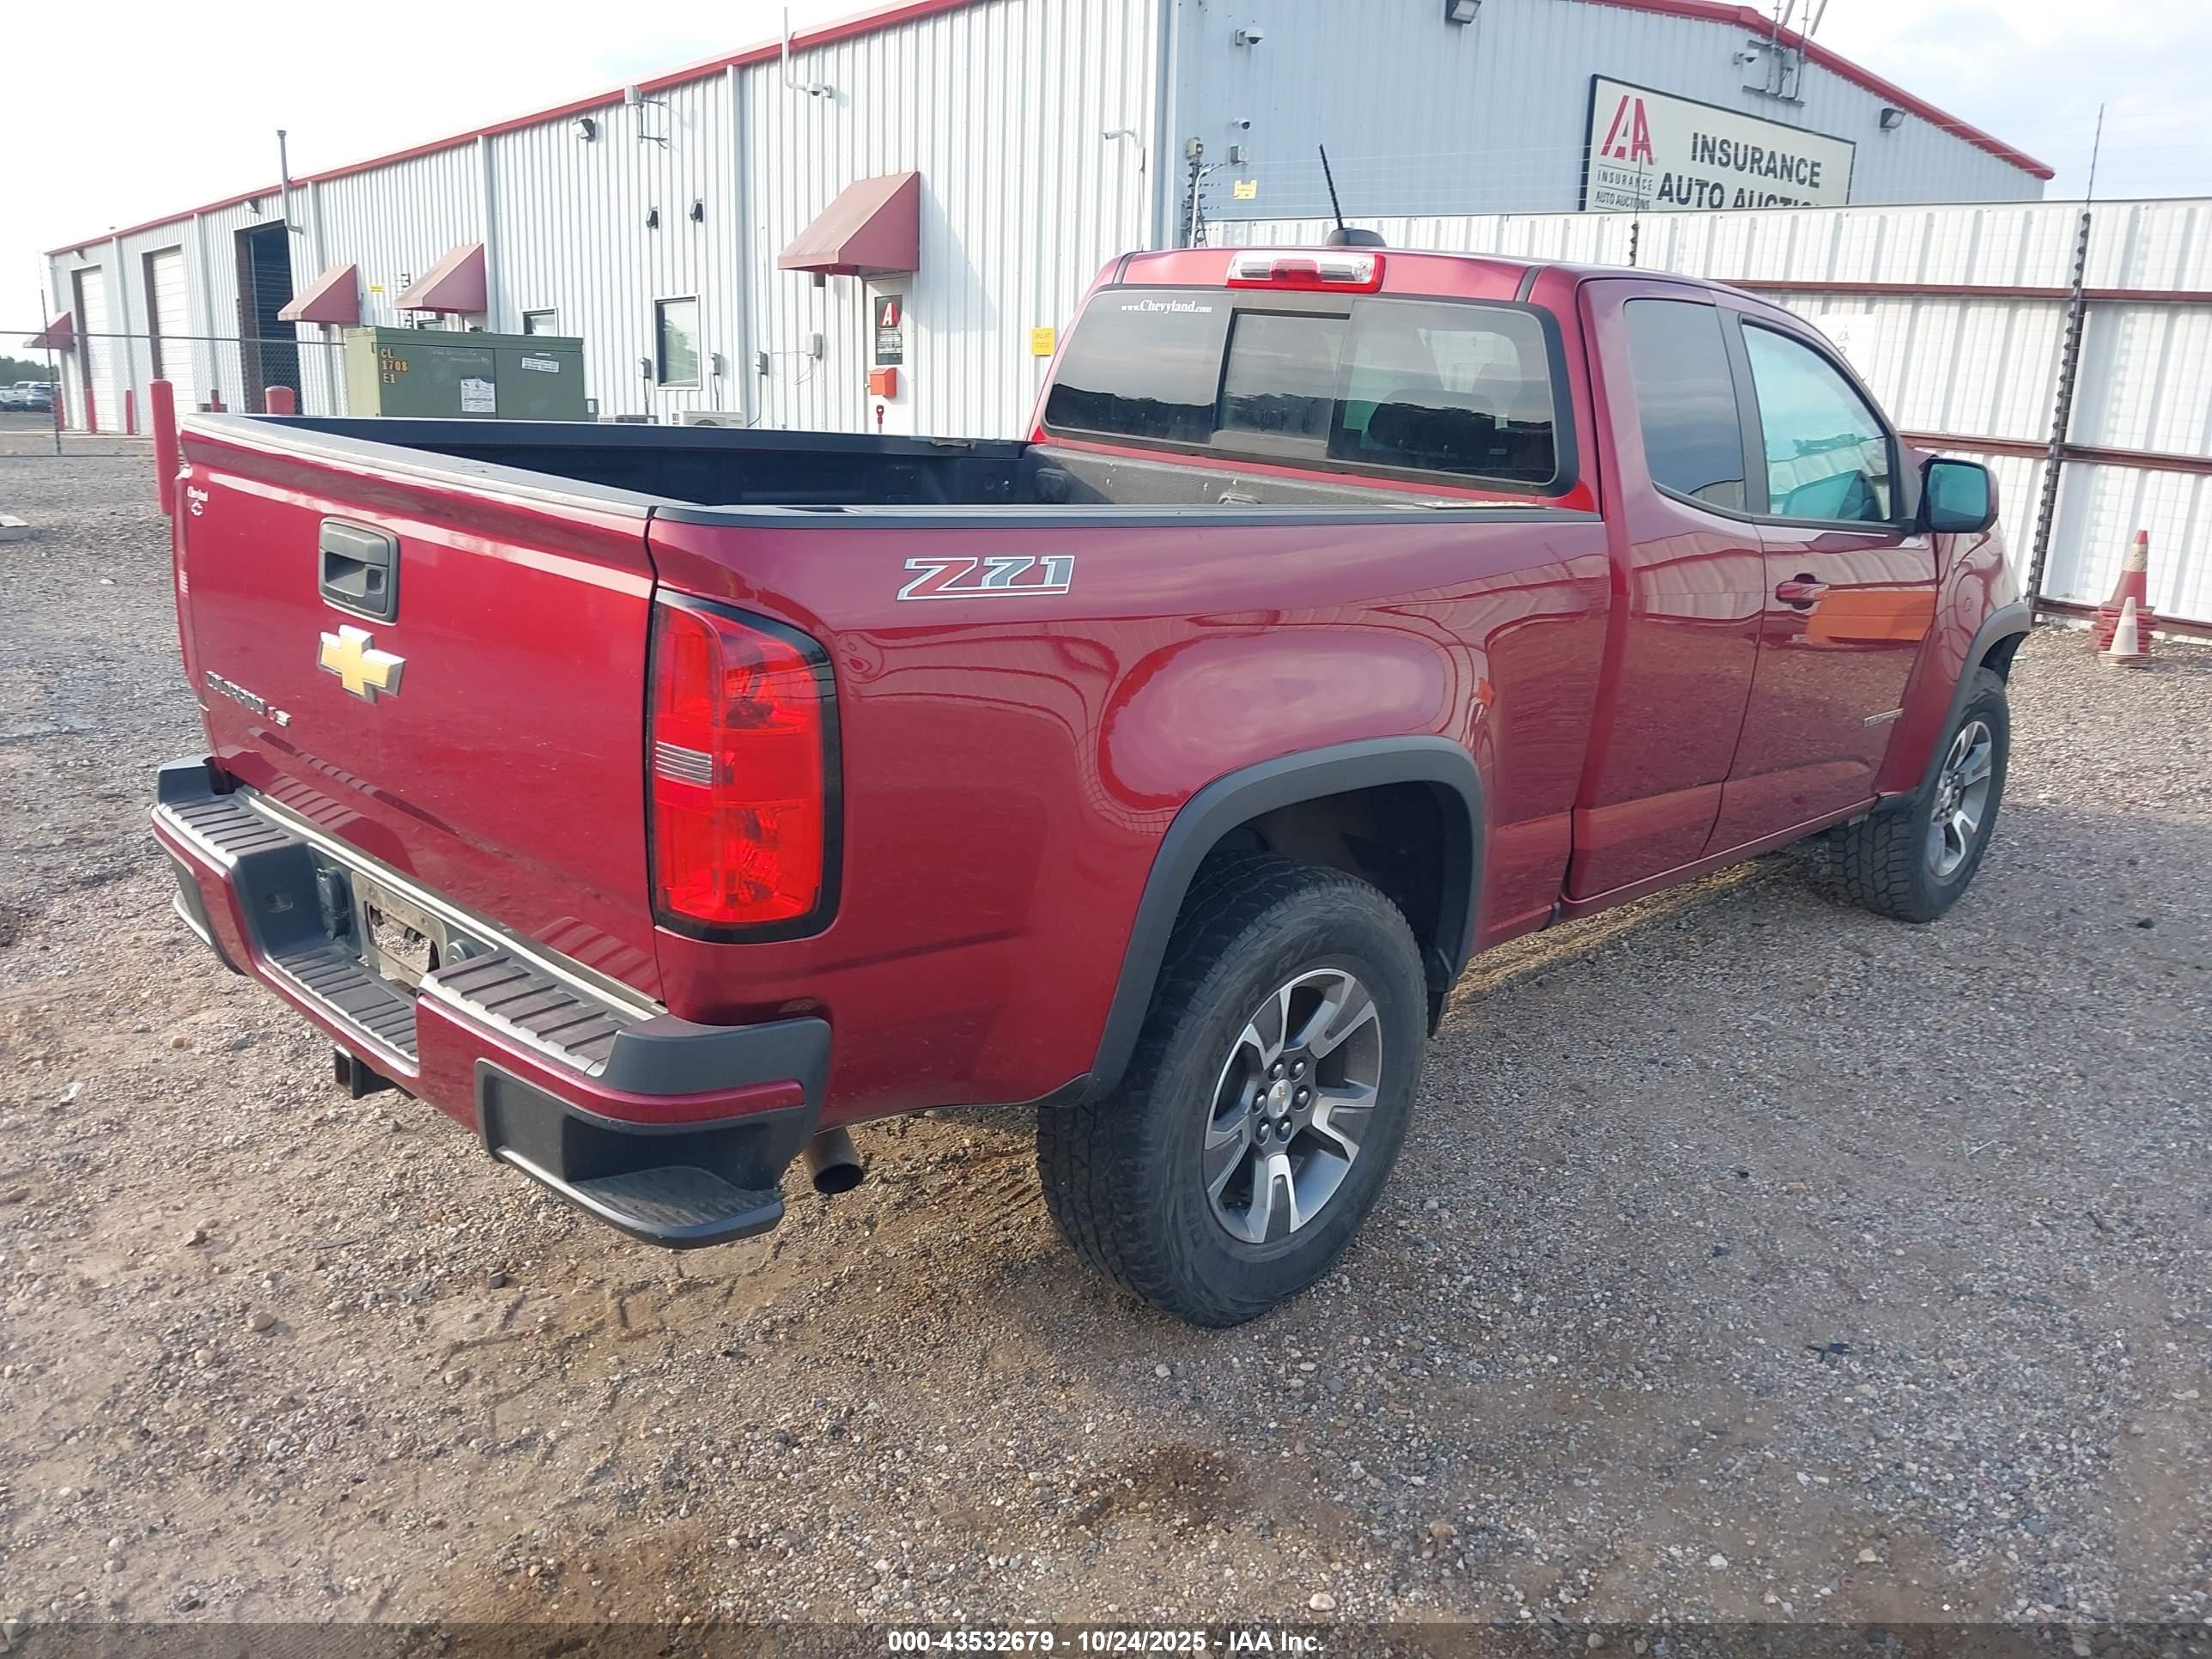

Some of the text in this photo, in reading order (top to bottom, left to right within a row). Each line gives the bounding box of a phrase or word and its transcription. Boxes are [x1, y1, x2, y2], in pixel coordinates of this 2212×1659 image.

[1690, 131, 1822, 189] INSURANCE
[1596, 169, 1654, 191] INSURANCE
[1595, 190, 1615, 205] AUTO
[1655, 172, 1726, 209] AUTO
[1120, 298, 1212, 315] www.Chevyland.com
[380, 348, 394, 359] CL
[382, 360, 409, 372] 1708
[383, 372, 396, 384] E1
[896, 555, 1076, 601] Z71
